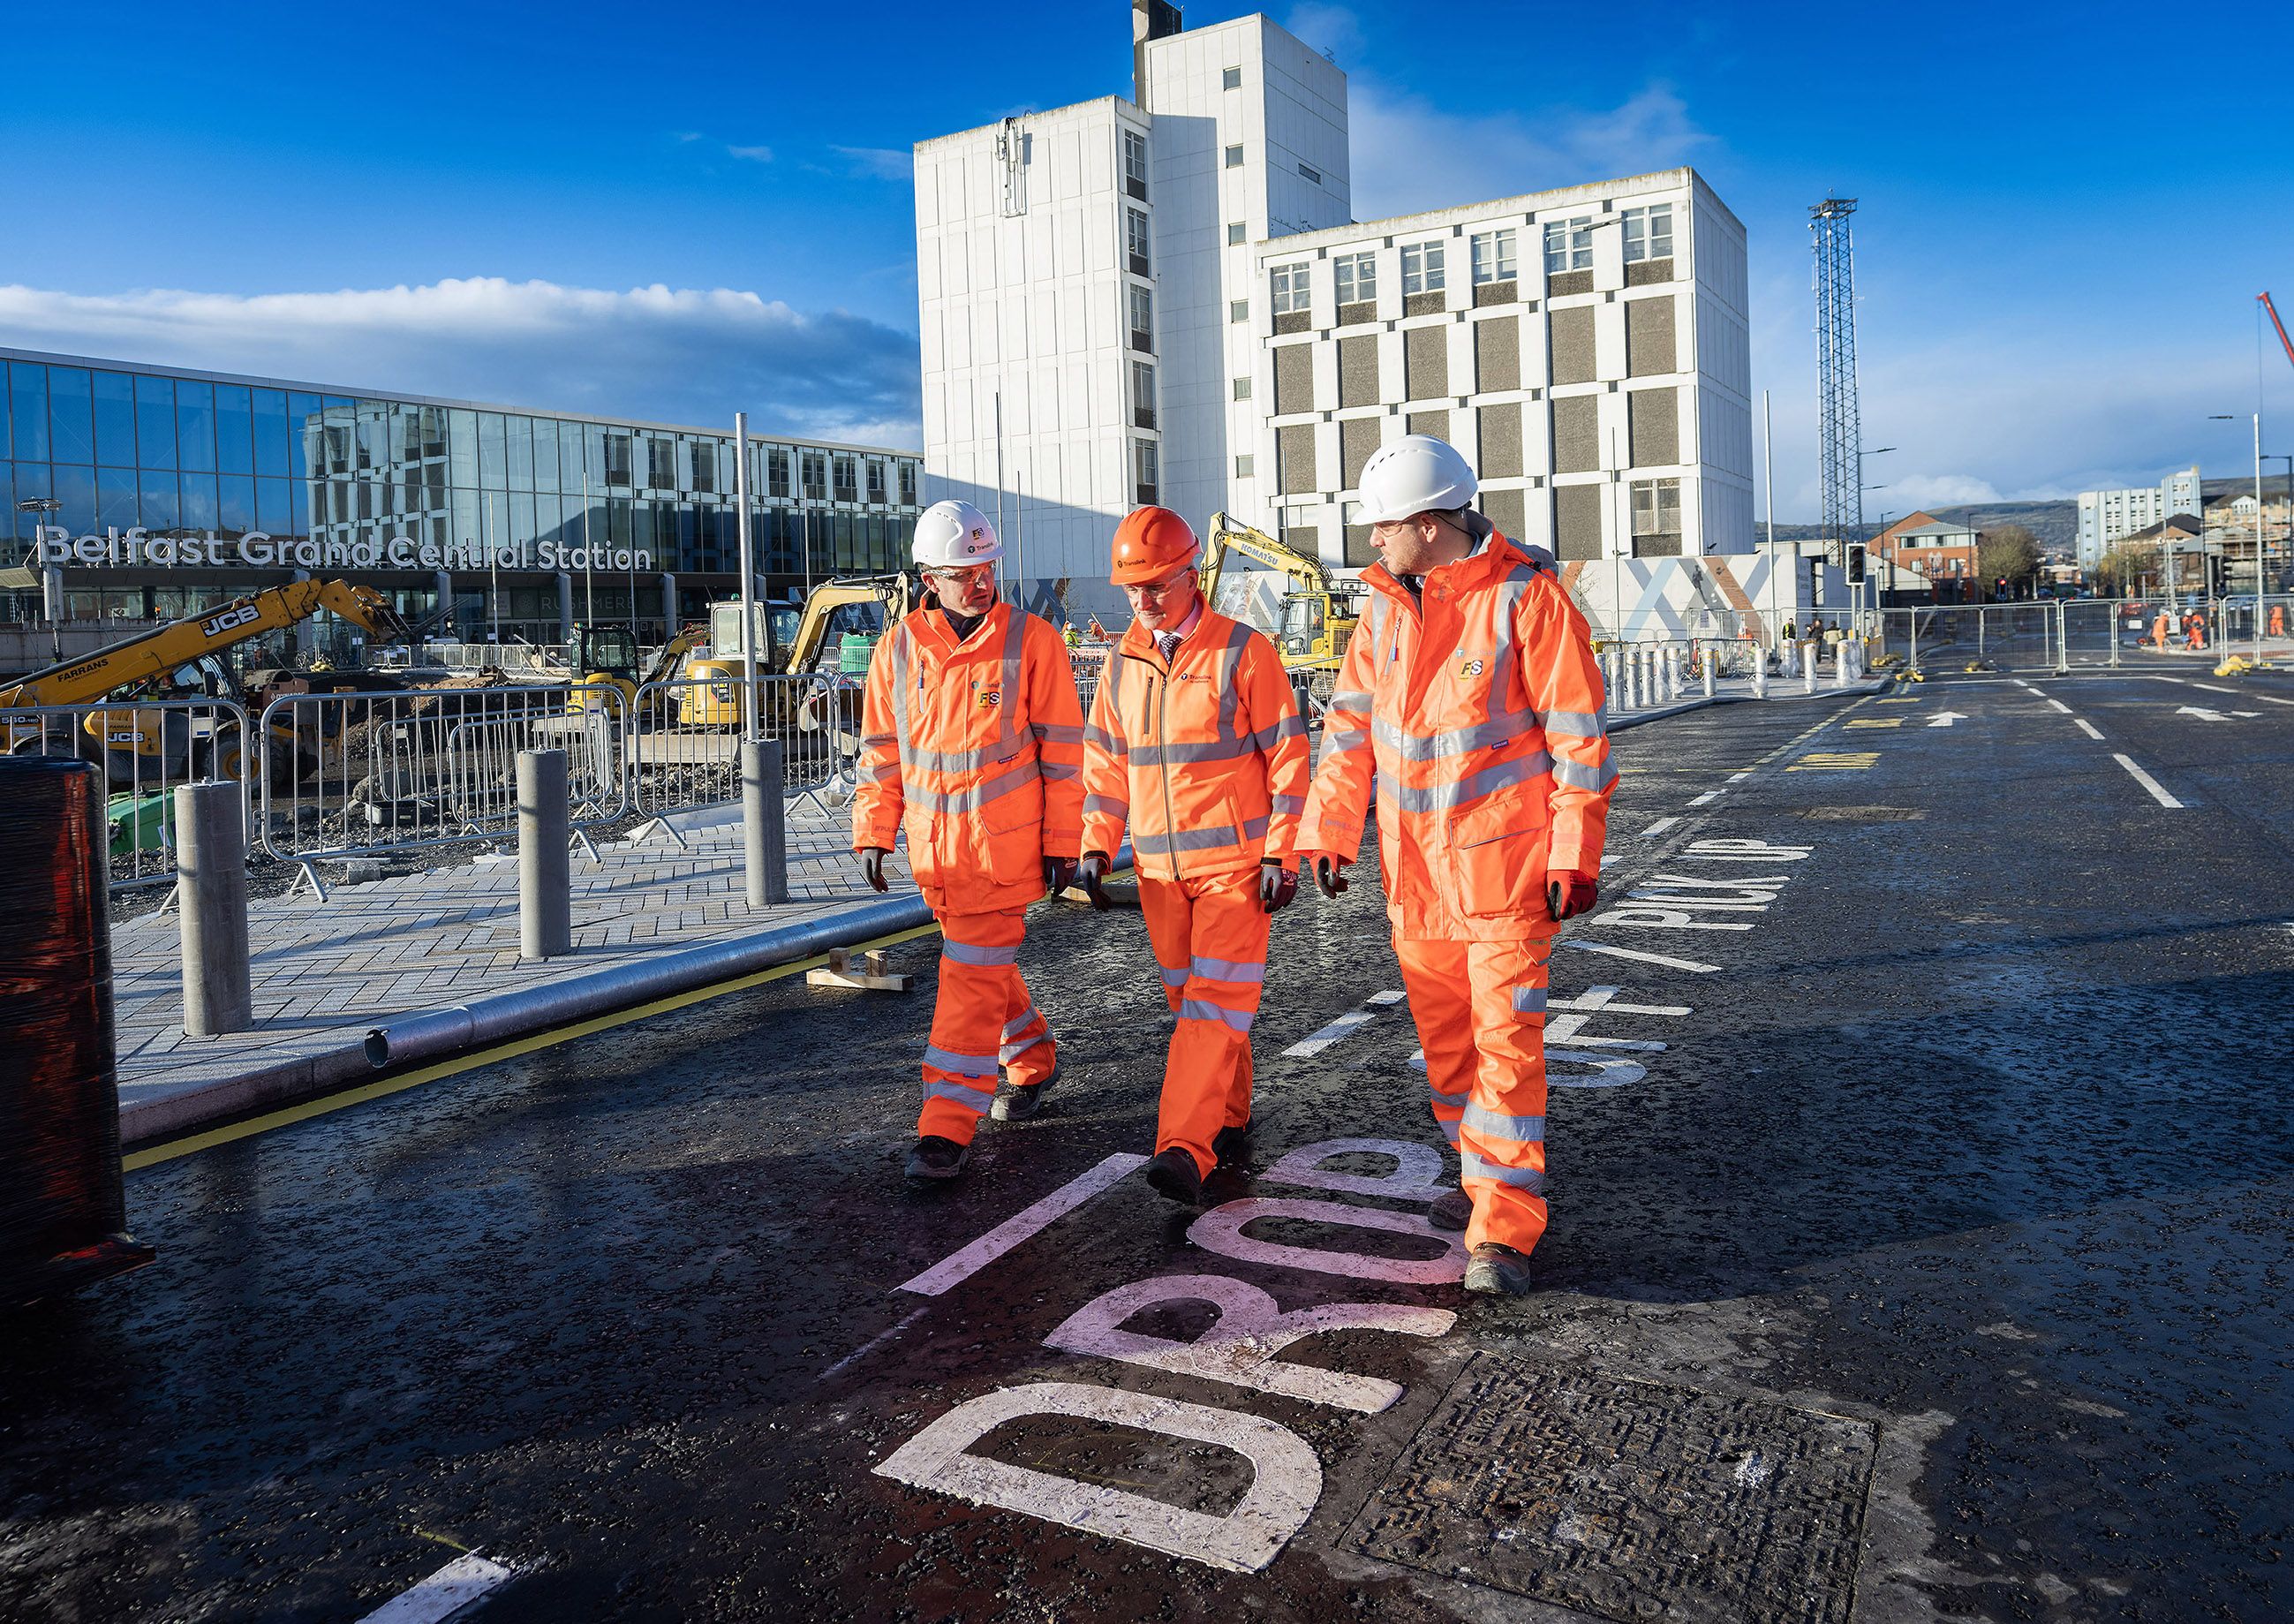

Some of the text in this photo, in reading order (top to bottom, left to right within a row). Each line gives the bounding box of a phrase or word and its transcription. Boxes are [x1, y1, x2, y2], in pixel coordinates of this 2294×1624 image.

[36, 525, 652, 570] Belfast Grand Central Station
[1241, 543, 1279, 565] KOMATSU
[204, 605, 260, 636] JCB
[57, 658, 109, 683] FARRANS
[107, 732, 144, 742] JCB
[1679, 839, 1815, 861] UP
[1590, 874, 1791, 930] PICK
[871, 1138, 1468, 1575] DROP
